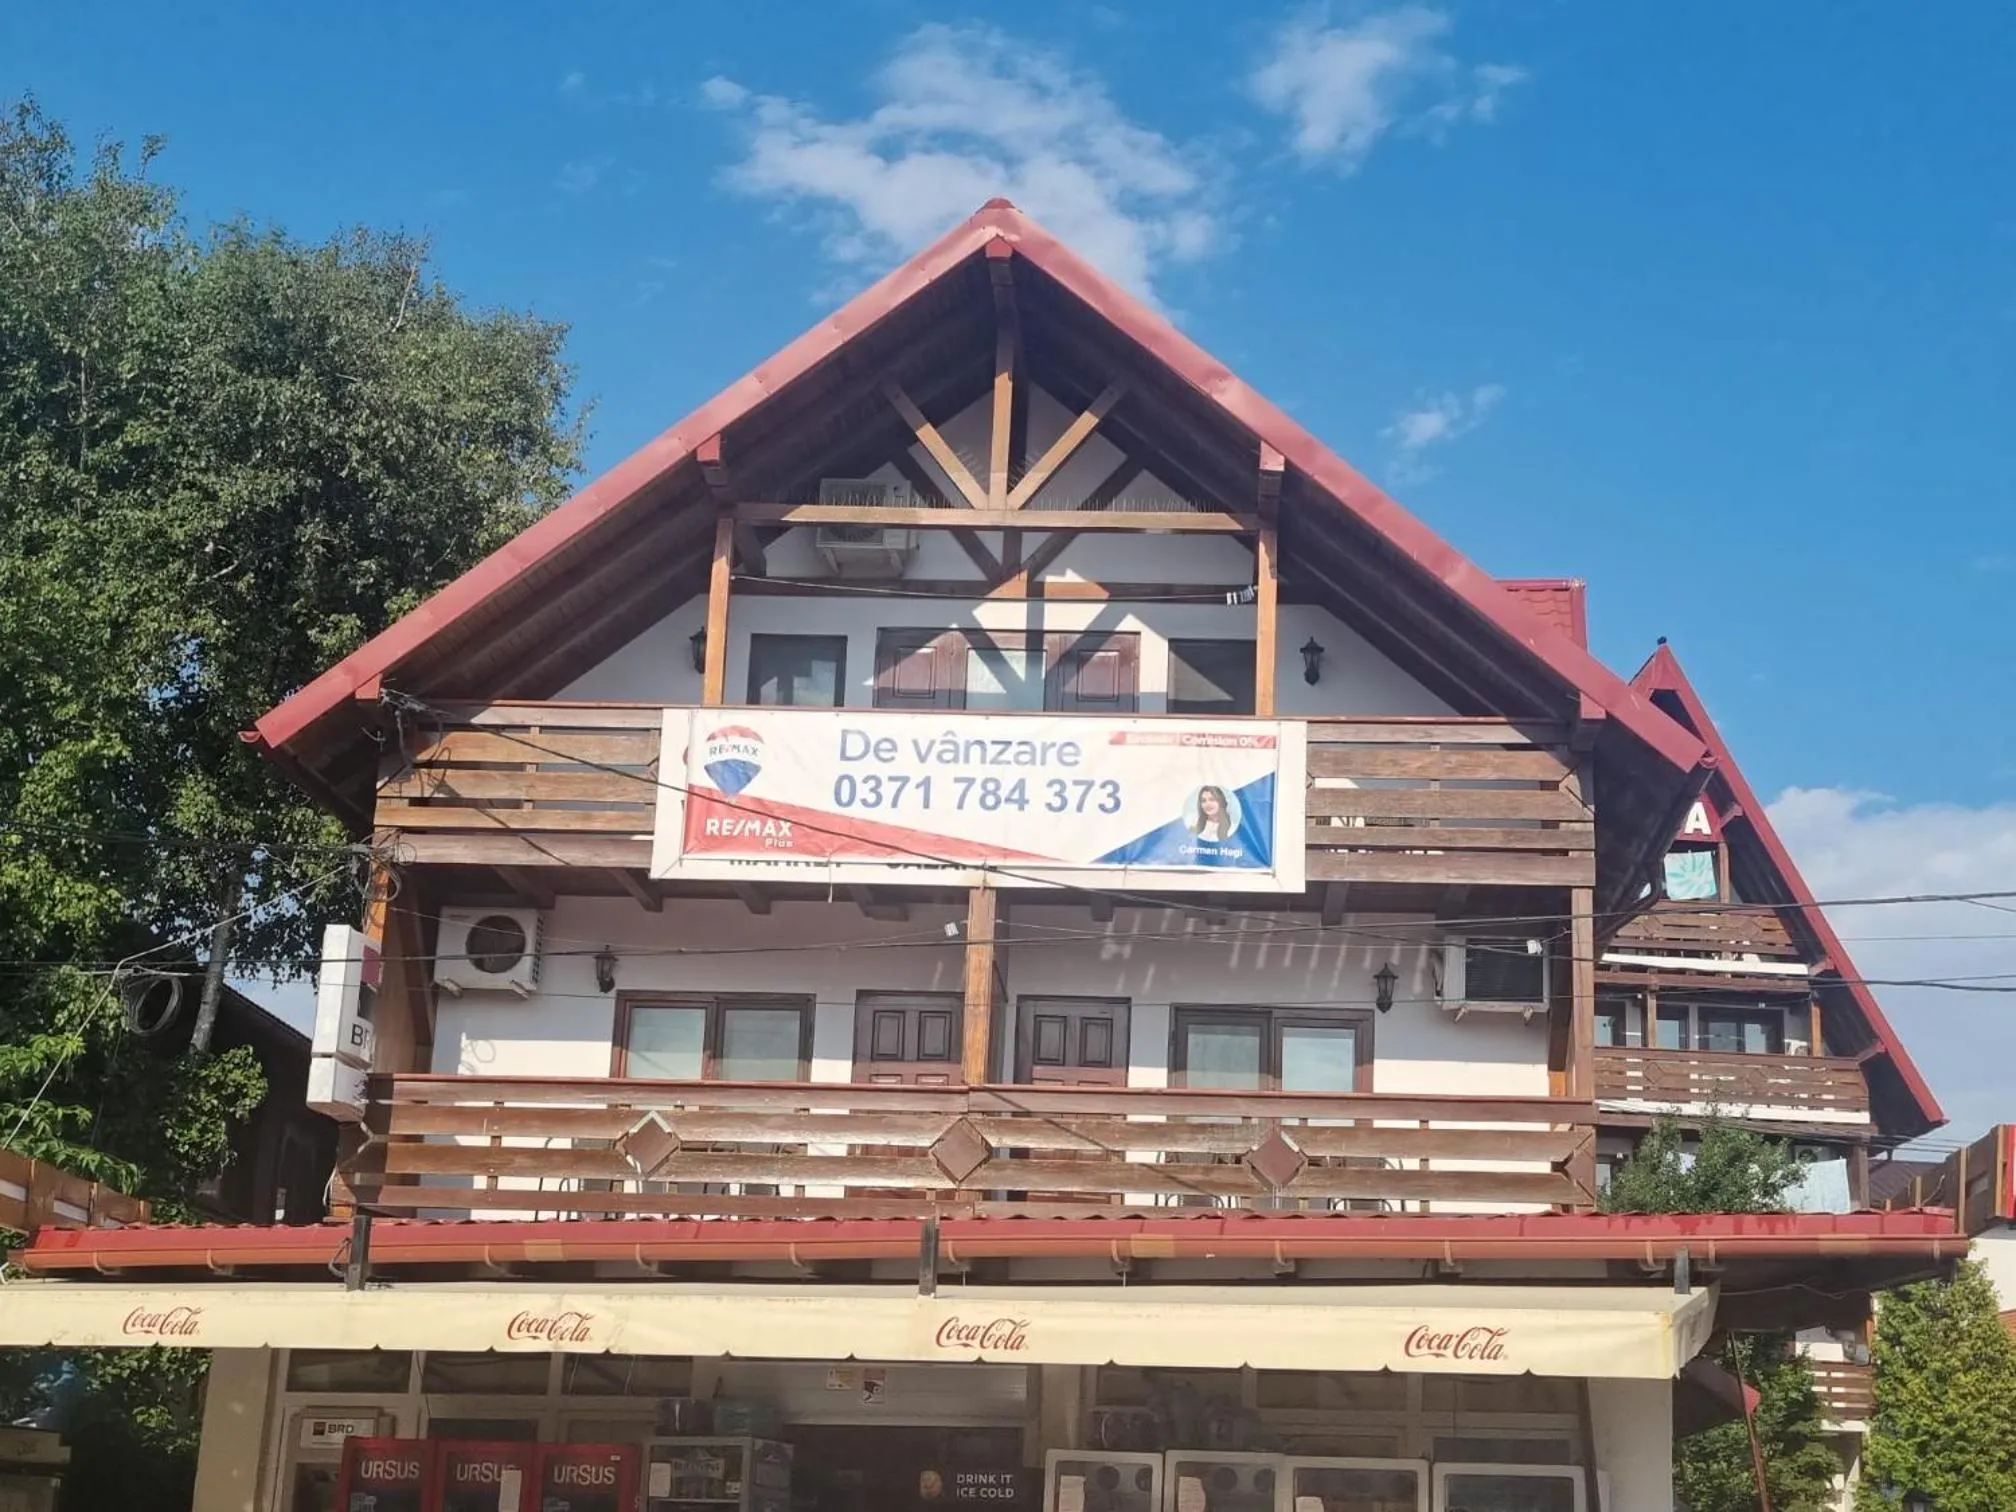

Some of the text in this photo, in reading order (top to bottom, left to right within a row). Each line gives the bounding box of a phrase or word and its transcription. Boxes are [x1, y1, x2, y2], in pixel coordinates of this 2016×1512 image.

[708, 743, 759, 757] RE/MAX
[839, 729, 1082, 767] De vânzare
[834, 774, 1122, 814] 0371 784 373
[706, 818, 793, 837] RE/MAX
[936, 1316, 1031, 1350] Coca-Cola
[1404, 1325, 1510, 1361] Coca-Cola
[361, 1460, 420, 1480] URSUS
[456, 1463, 519, 1482] URSU
[553, 1464, 616, 1485] URSUS
[956, 1473, 1014, 1484] DRINK IT
[956, 1487, 1014, 1499] ICE COLD
